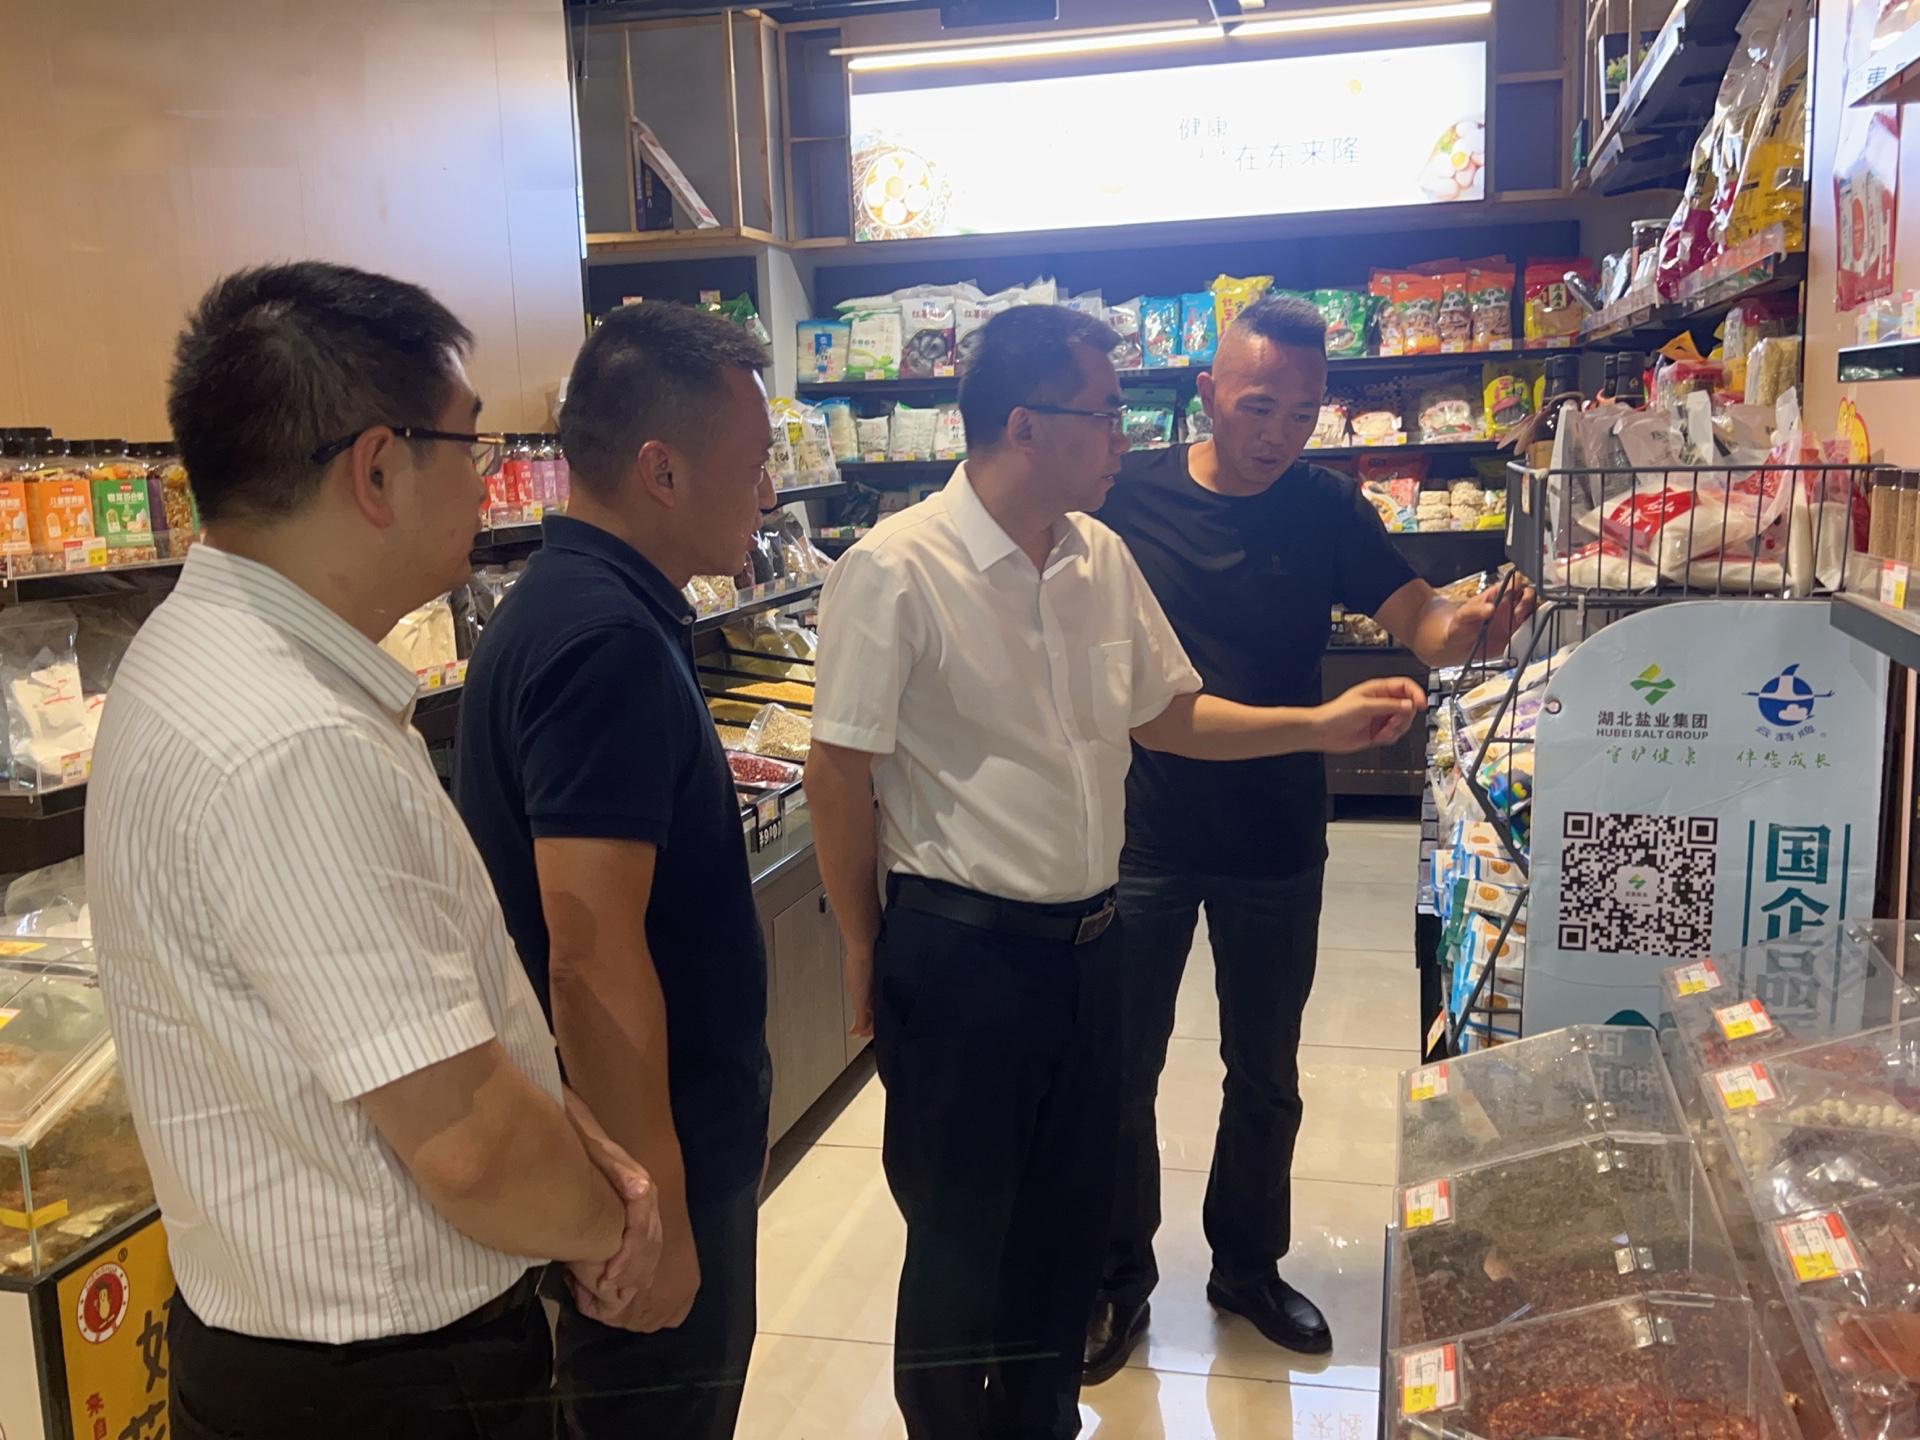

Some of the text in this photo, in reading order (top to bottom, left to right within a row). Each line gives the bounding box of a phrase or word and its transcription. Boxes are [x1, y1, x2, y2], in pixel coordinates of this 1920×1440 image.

[1178, 116, 1228, 140] 健康
[1235, 136, 1360, 172] 在东来隆
[1597, 710, 1708, 729] 湖北盐业集团
[1596, 728, 1709, 740] HUBEI SALT GROUP
[1736, 748, 1832, 769] 伴您成长
